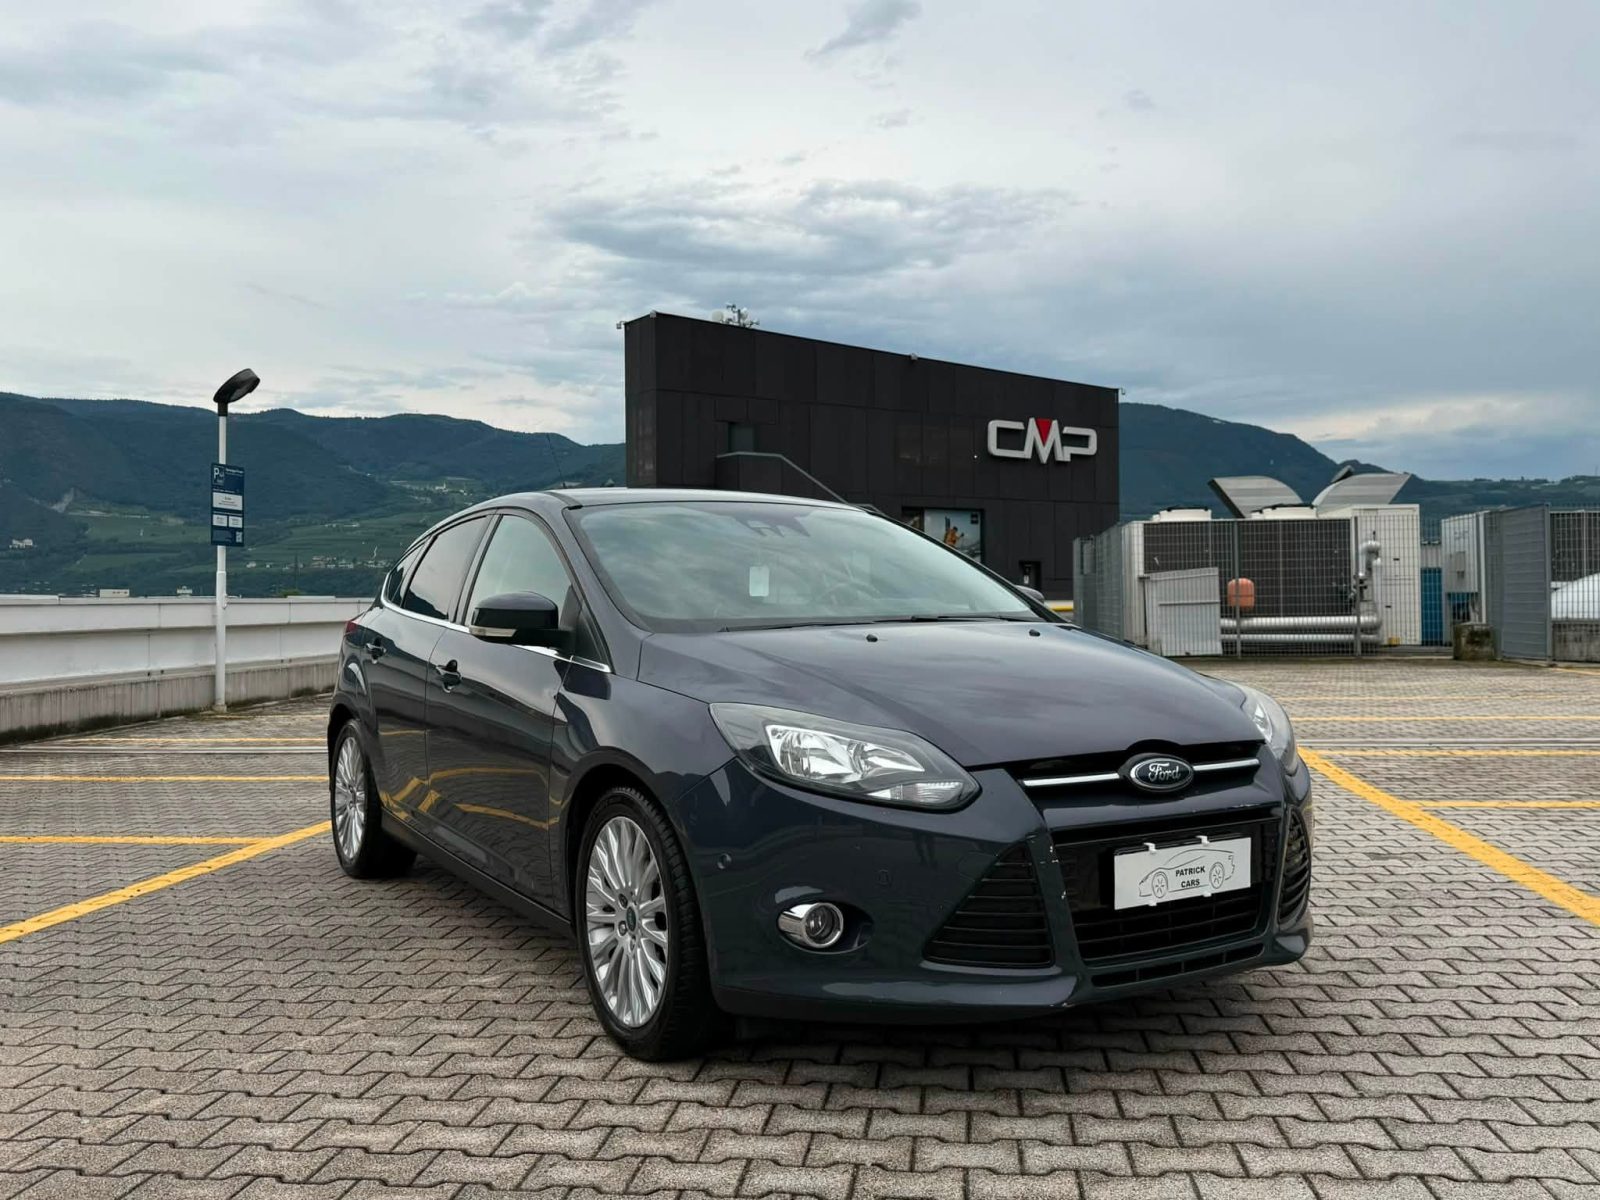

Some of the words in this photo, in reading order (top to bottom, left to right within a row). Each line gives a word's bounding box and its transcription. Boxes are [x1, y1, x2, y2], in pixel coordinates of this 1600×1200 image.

[987, 417, 1097, 464] CMP
[1148, 762, 1180, 782] Ford
[1175, 866, 1206, 877] PATRICK
[1181, 879, 1200, 888] CARS
